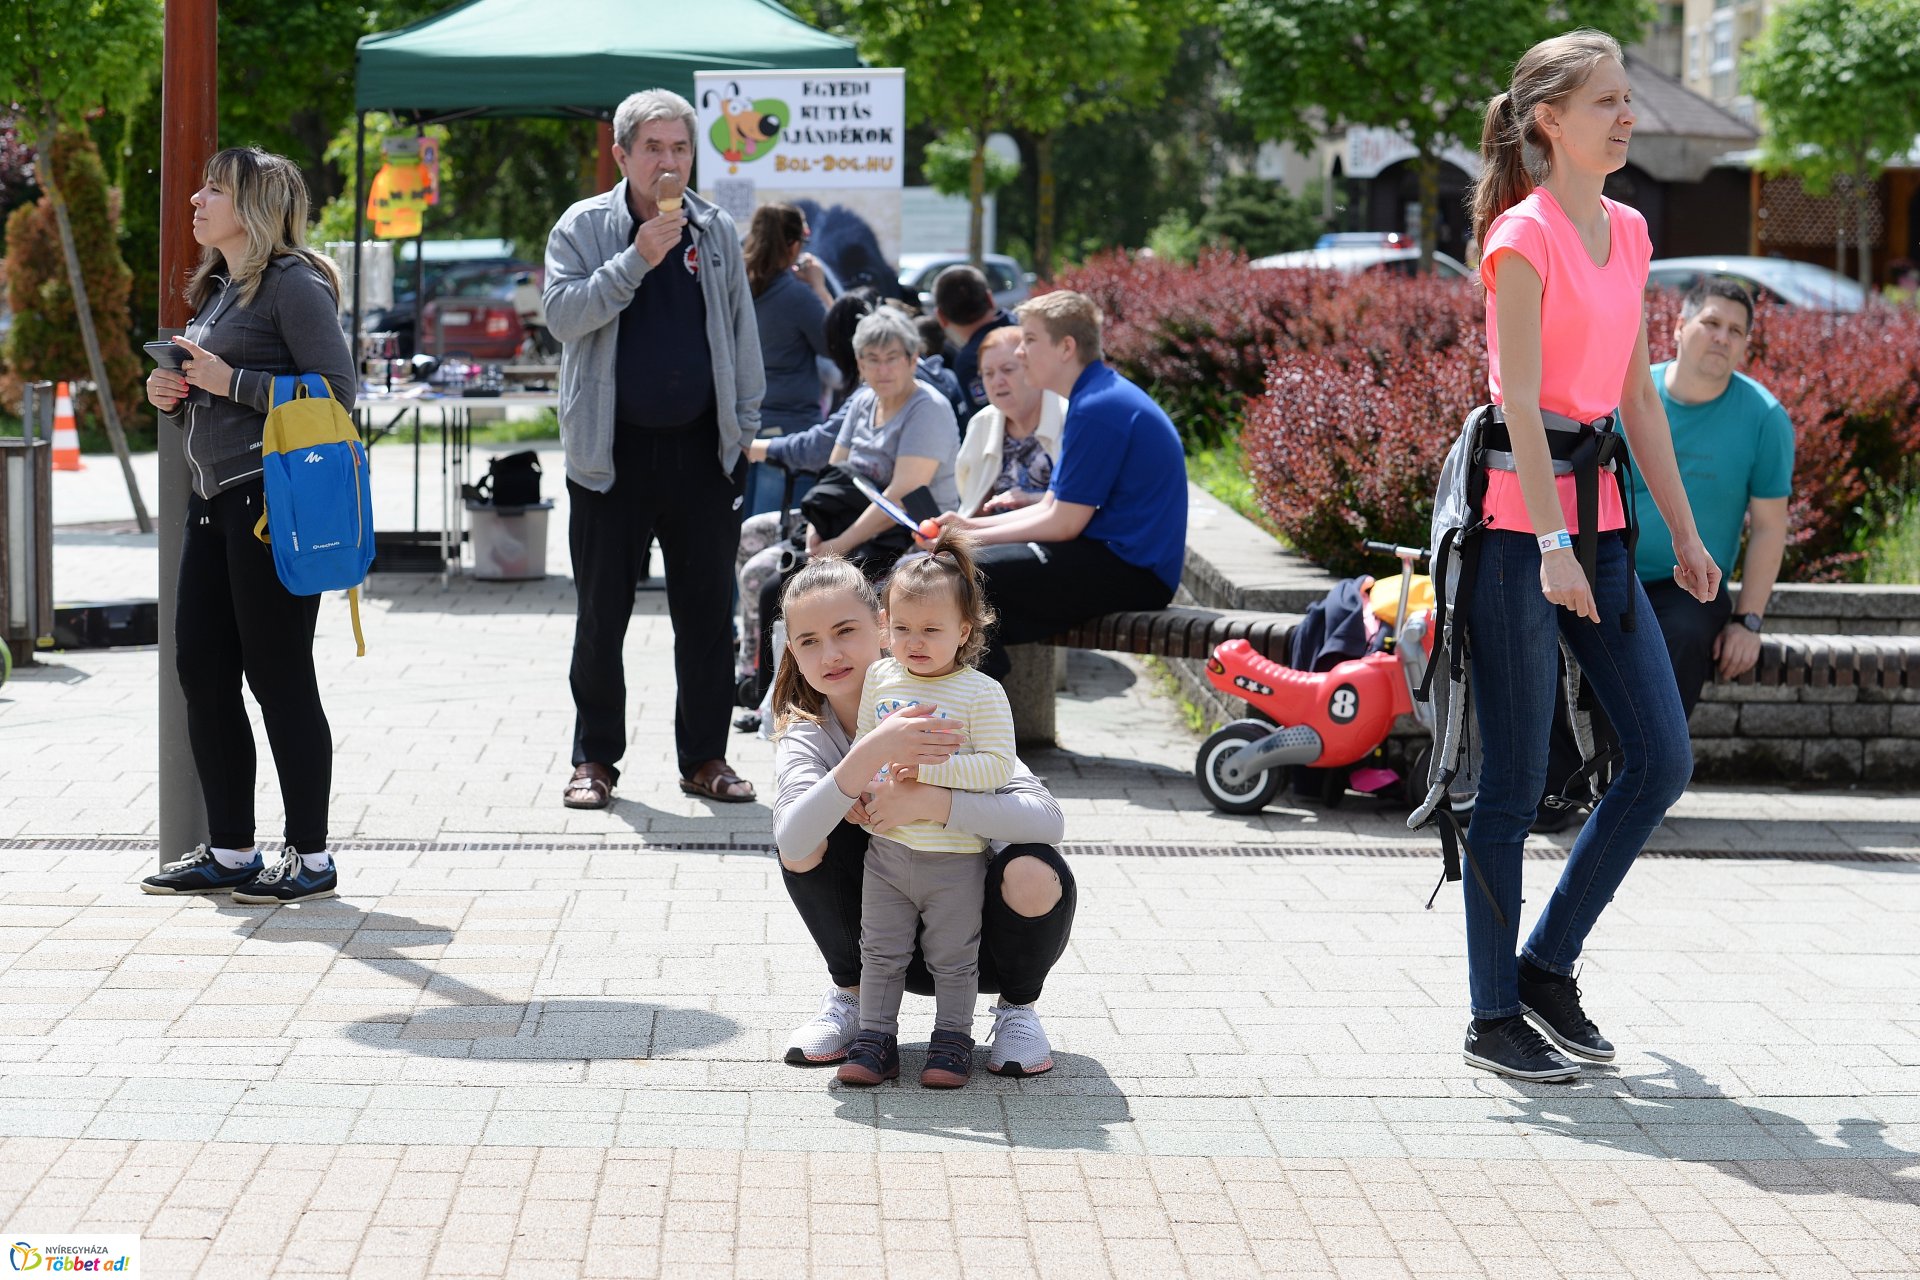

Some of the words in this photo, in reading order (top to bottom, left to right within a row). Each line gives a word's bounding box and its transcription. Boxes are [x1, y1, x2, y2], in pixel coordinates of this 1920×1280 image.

[802, 80, 870, 97] EGYEDI
[800, 102, 872, 120] KUTYÁS
[783, 126, 893, 145] AJÁNDÉKOK
[312, 541, 340, 550] Quechua
[1331, 689, 1356, 718] 8
